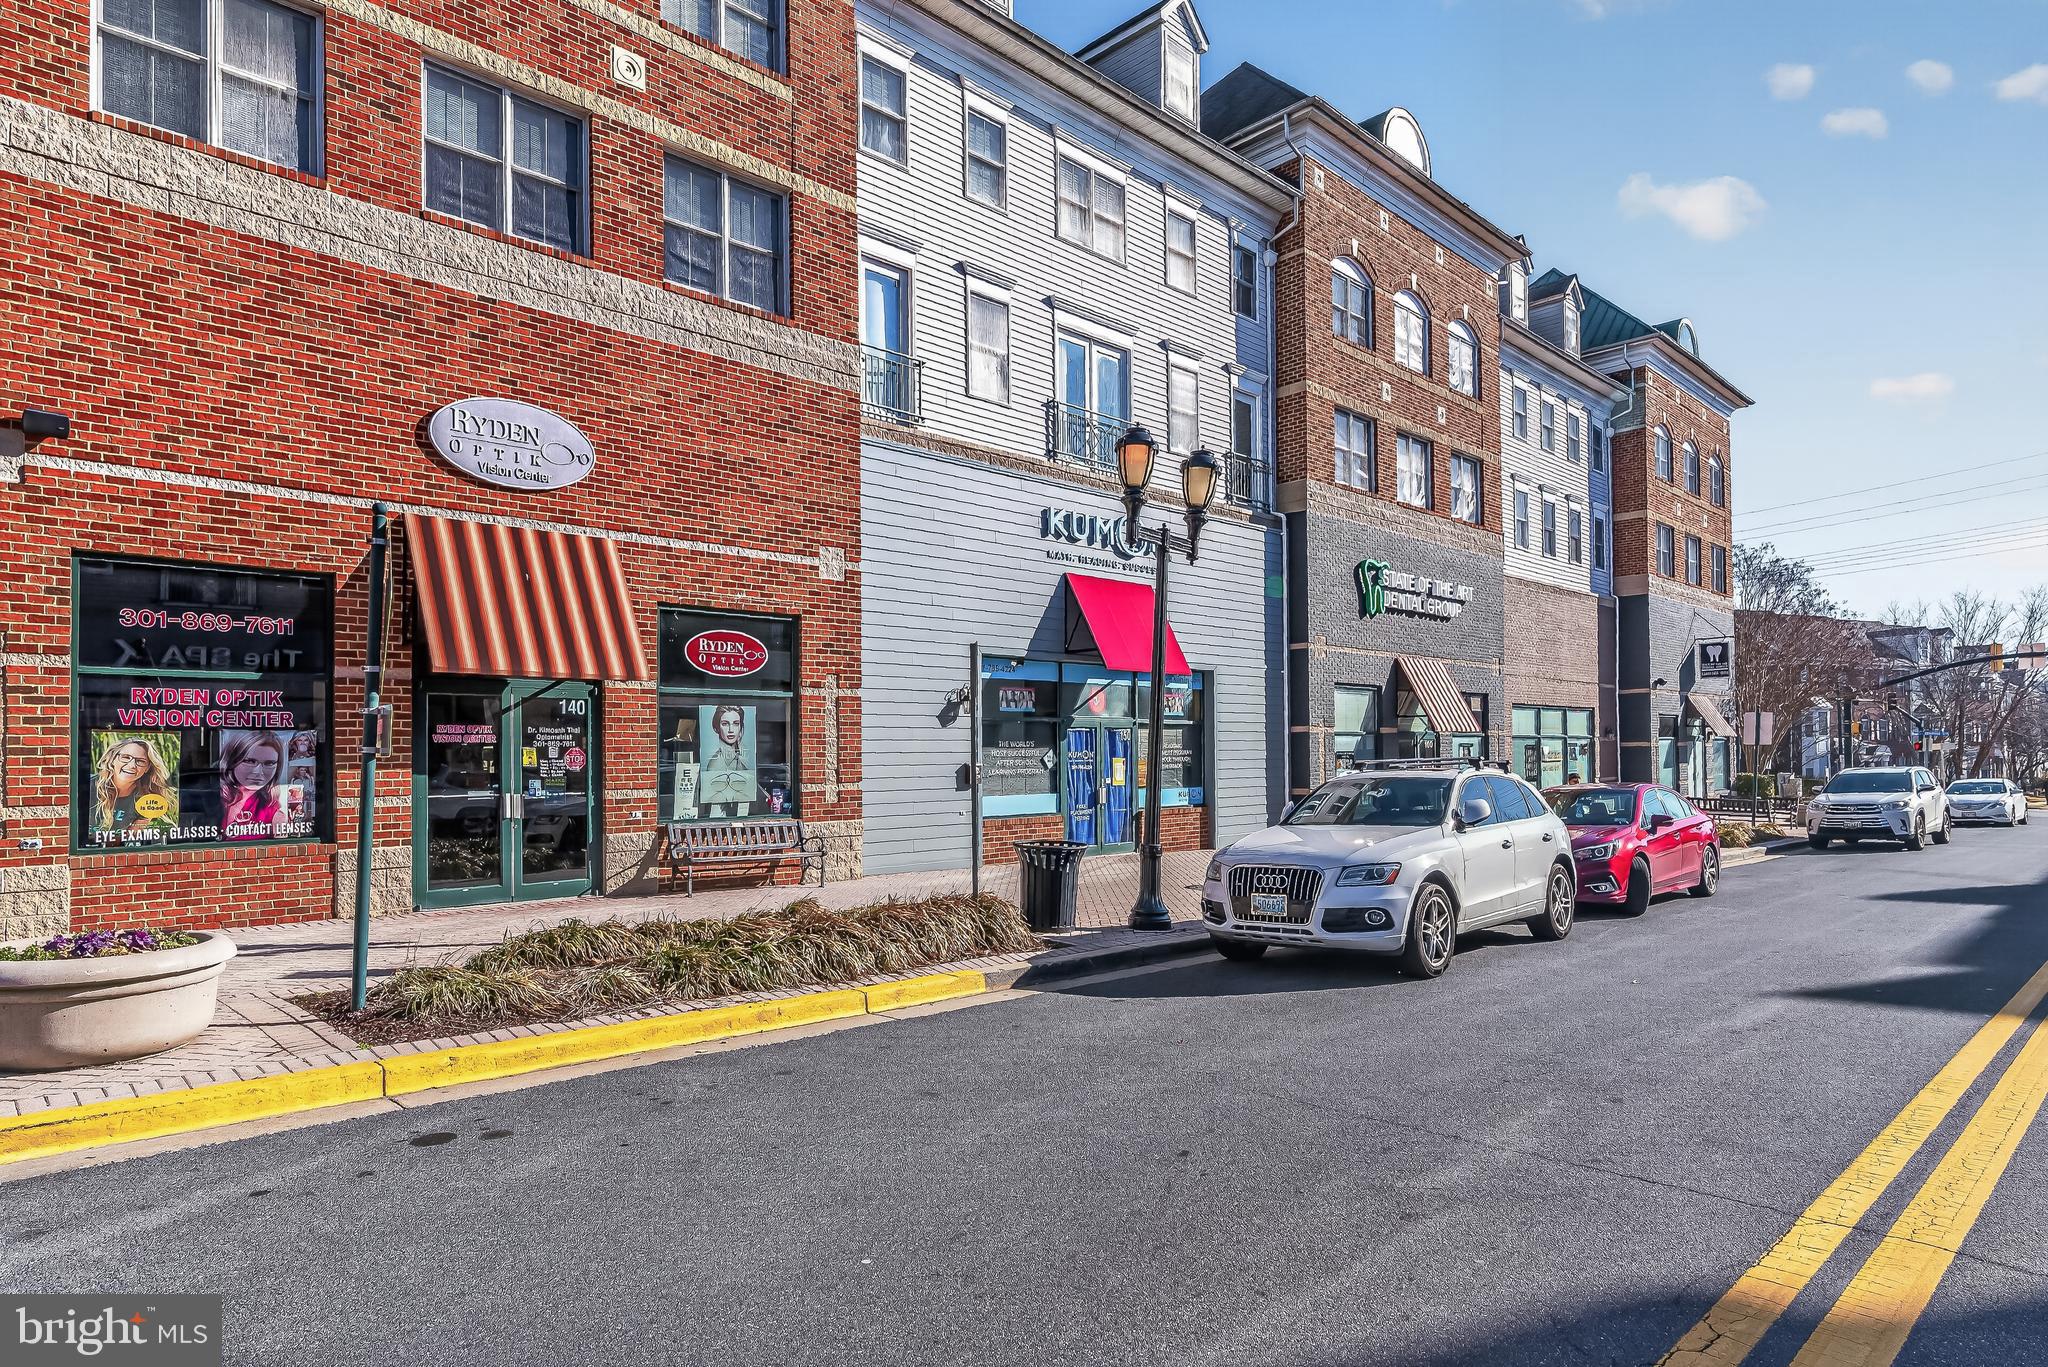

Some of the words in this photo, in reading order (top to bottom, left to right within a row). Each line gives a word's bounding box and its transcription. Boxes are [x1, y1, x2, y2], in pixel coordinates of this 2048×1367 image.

[450, 408, 540, 446] RYDEN
[449, 439, 542, 467] OPTIK
[477, 461, 512, 478] Vision
[515, 467, 552, 484] Center
[1383, 569, 1416, 591] STATE
[1419, 576, 1433, 593] OF
[1435, 580, 1454, 597] THE
[1456, 585, 1475, 602] ART
[1384, 590, 1425, 613] DENTAL
[1427, 598, 1462, 618] GROUP
[119, 608, 294, 636] 301-869-7611
[699, 638, 745, 653] RYDEN
[699, 653, 745, 665] OPTIK
[730, 665, 749, 673] Center
[131, 687, 210, 706] RYDEN
[216, 688, 283, 707] OPTIK
[559, 699, 586, 715] 140
[118, 709, 200, 726] VISION
[207, 710, 295, 728] CENTER
[436, 724, 465, 734] RYDEN
[466, 724, 493, 734] OPTIK
[567, 726, 581, 734] Thai
[1120, 730, 1131, 741] 150
[432, 734, 462, 743] VISION
[463, 734, 497, 744] CENTER
[999, 740, 1009, 748] THE
[1010, 740, 1035, 748] WORLD'S
[566, 755, 584, 763] STOP
[1068, 750, 1095, 760] KUMON
[95, 831, 116, 843] EYE
[121, 828, 161, 841] EXAMS
[170, 825, 218, 840] GLASSES
[226, 823, 272, 837] CONTACT
[276, 822, 313, 835] LENSES
